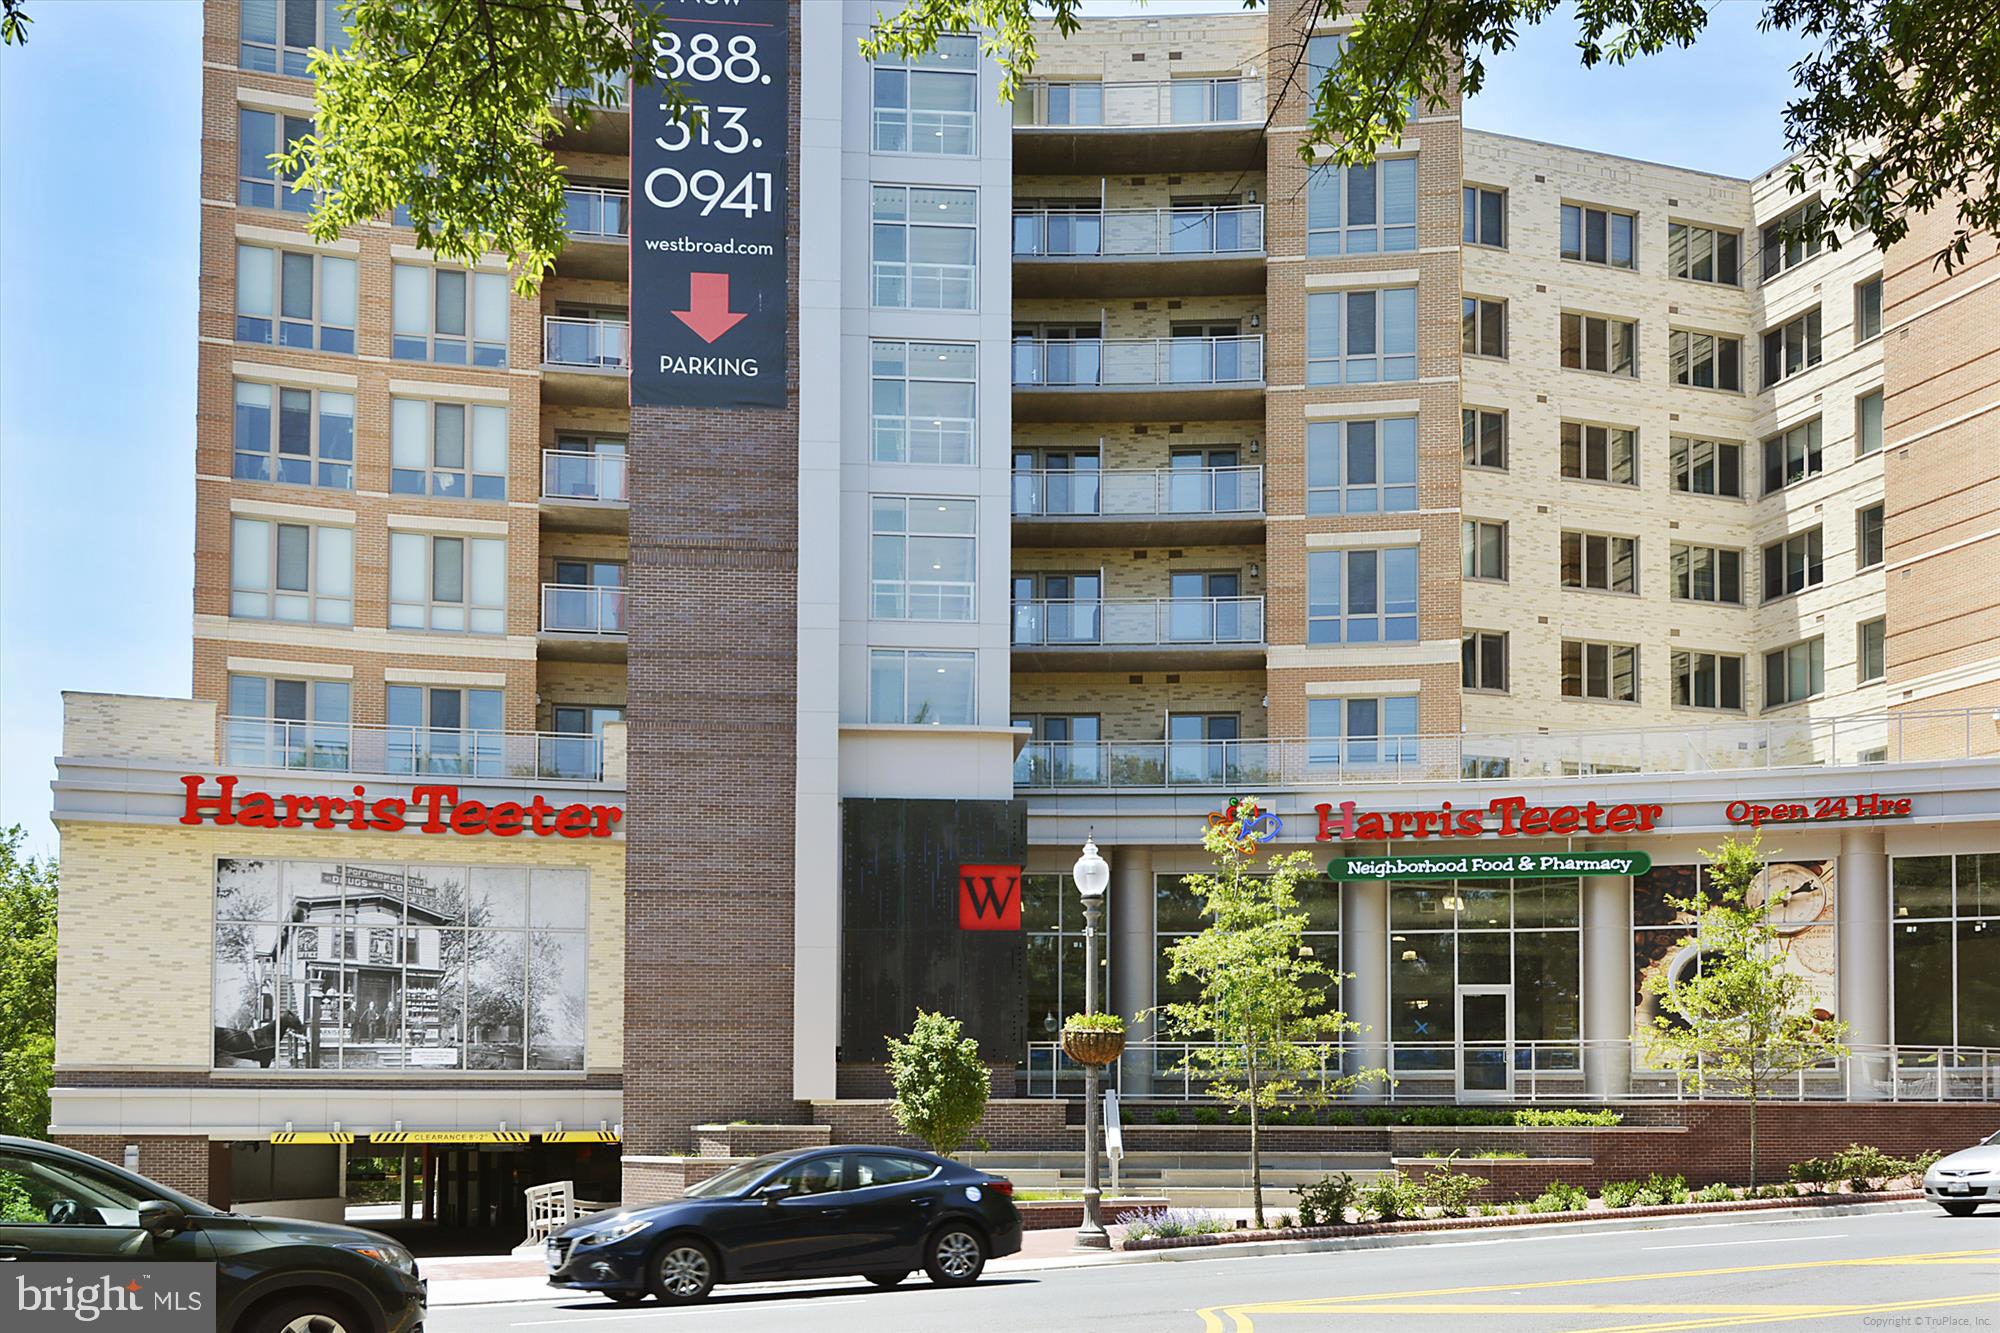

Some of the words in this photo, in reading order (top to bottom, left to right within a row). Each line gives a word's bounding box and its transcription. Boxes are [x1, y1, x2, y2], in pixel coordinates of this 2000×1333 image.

[650, 32, 772, 85] 888.
[655, 103, 763, 154] 313.
[644, 167, 773, 219] 0941
[645, 236, 774, 256] westbroad.com
[660, 355, 759, 377] PARKING
[179, 775, 407, 831] Harris
[412, 784, 623, 839] Teeter
[1314, 800, 1484, 843] Harris
[1489, 795, 1664, 838] Teeter
[1725, 800, 1810, 828] Open
[1814, 797, 1849, 819] 24
[1855, 793, 1912, 816] Hrs
[332, 875, 369, 888] DUGS
[383, 882, 429, 897] MEDCINE
[1347, 858, 1469, 879] Neighborhood
[1471, 857, 1516, 875] Food
[1518, 855, 1536, 872] &
[1540, 855, 1633, 874] Pharmacy
[962, 876, 1019, 920] W
[414, 1133, 467, 1141] CLEARANCE
